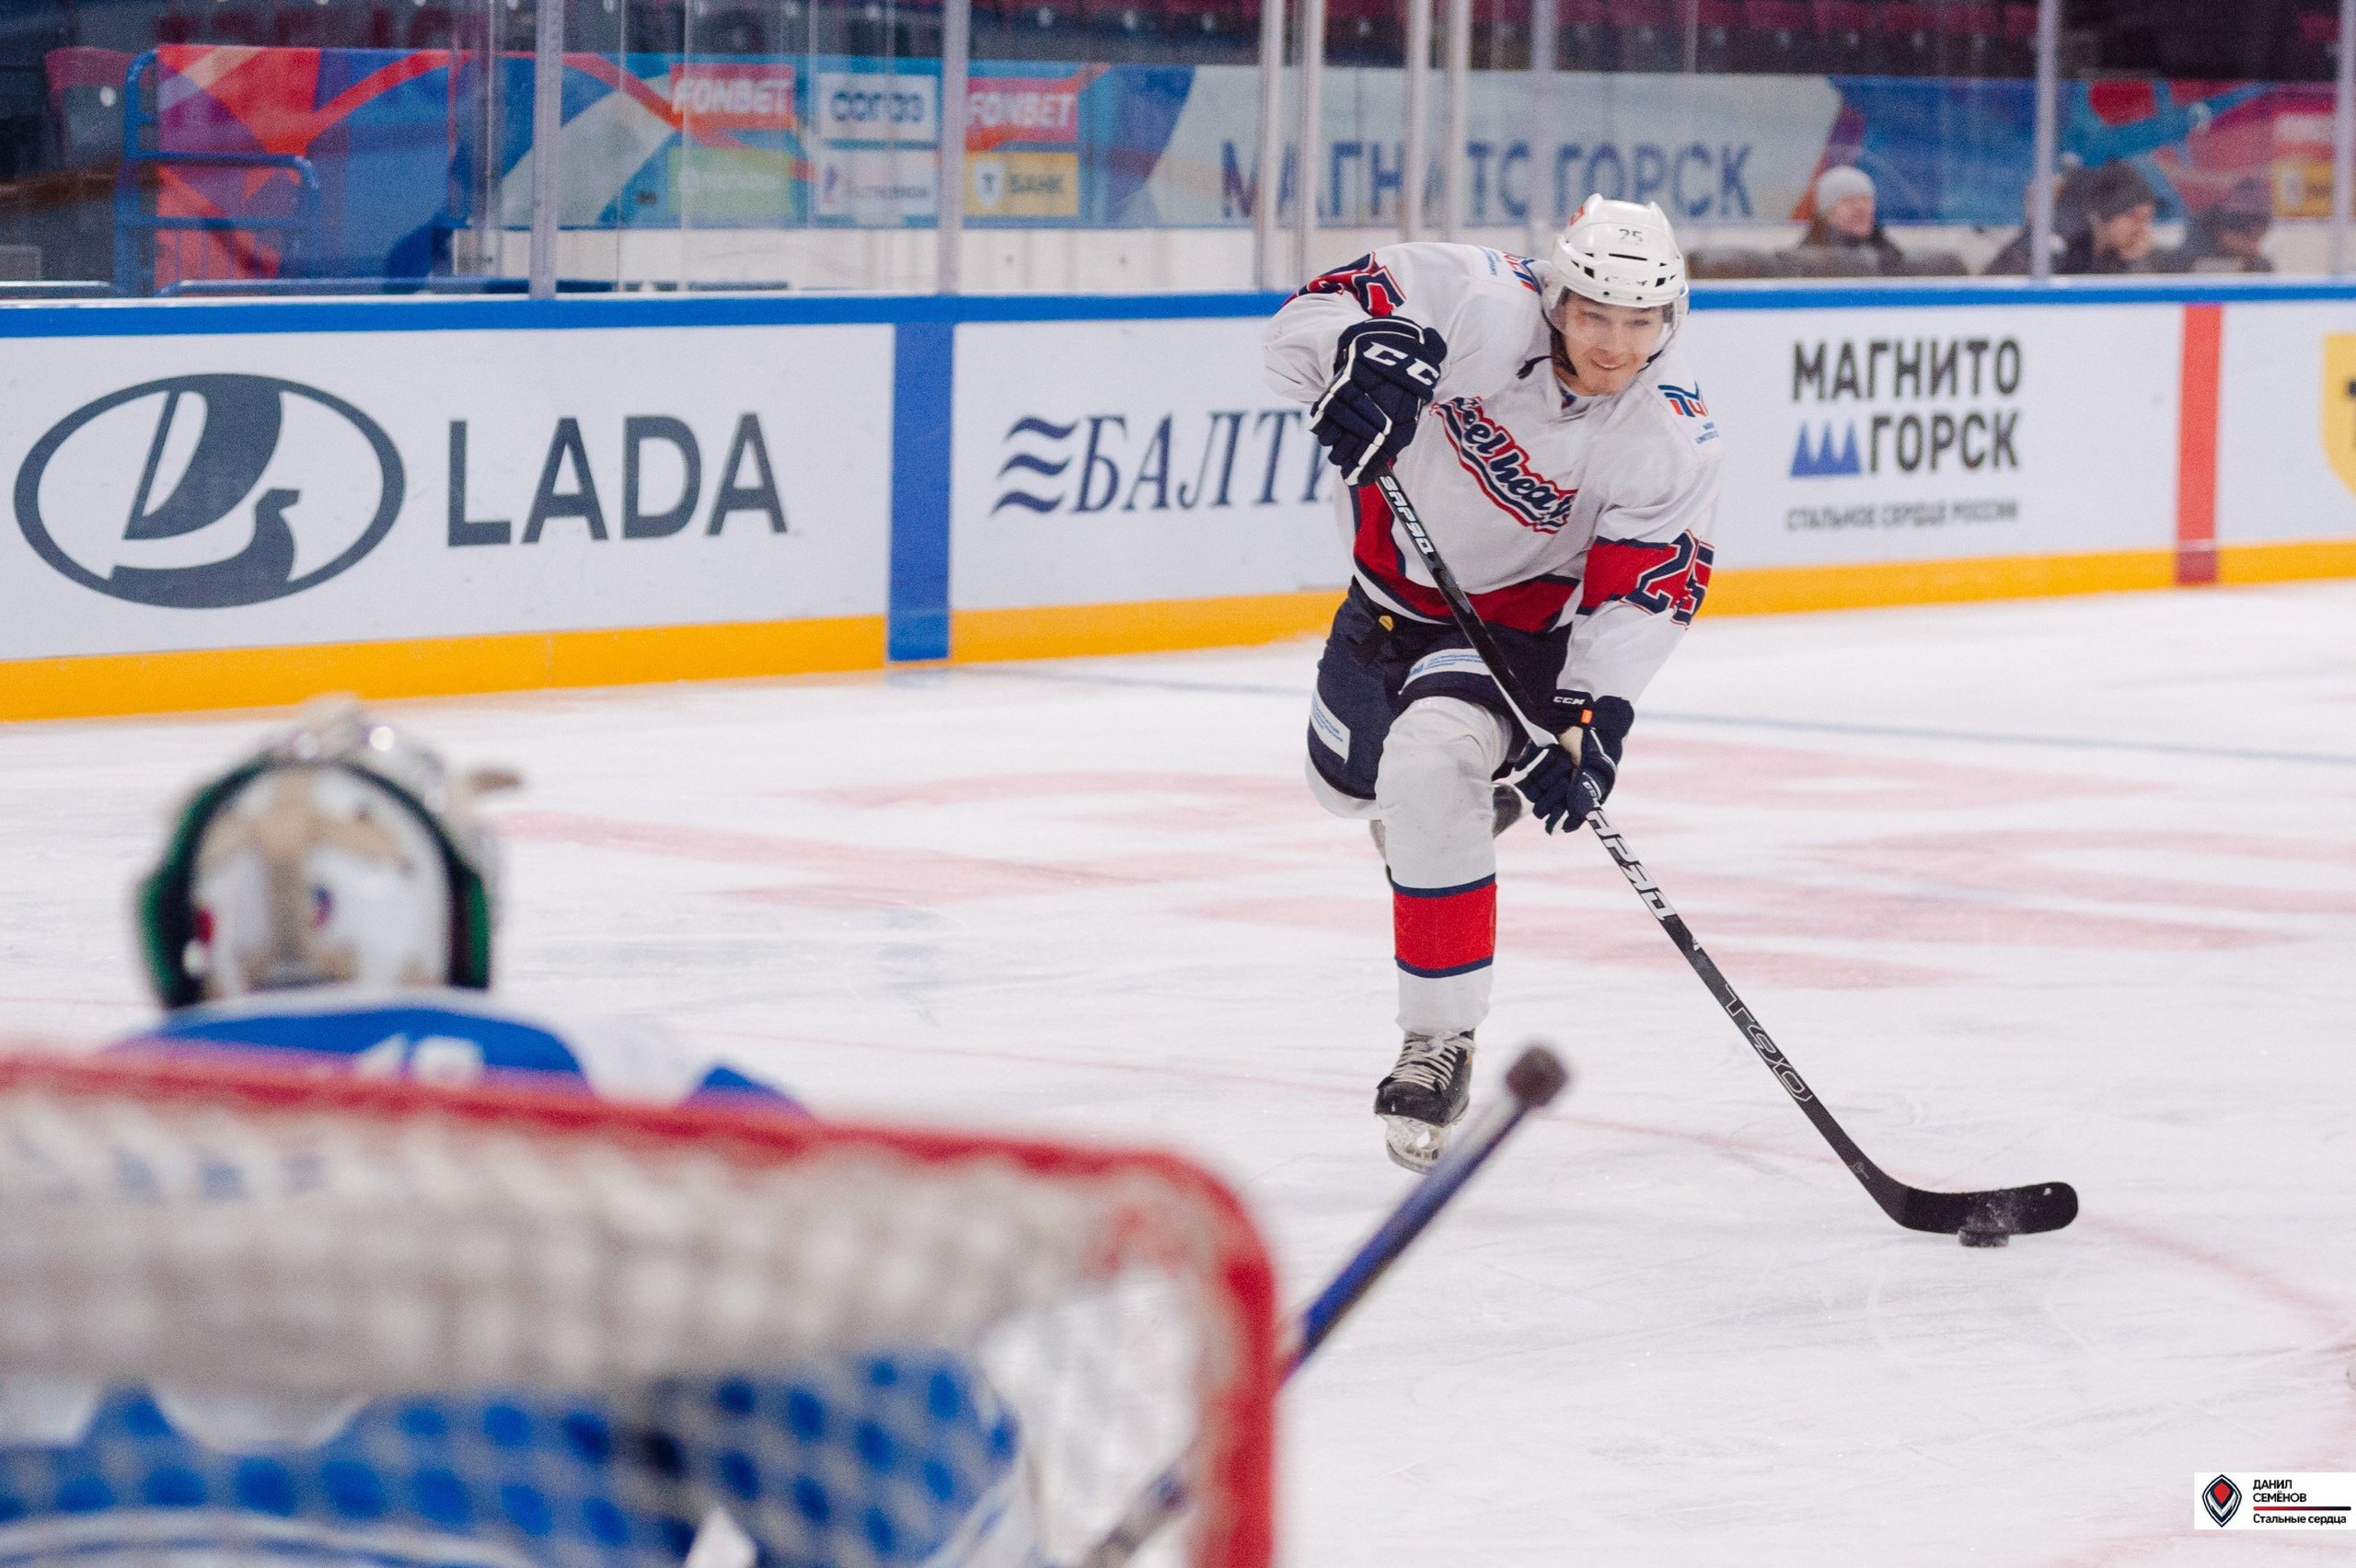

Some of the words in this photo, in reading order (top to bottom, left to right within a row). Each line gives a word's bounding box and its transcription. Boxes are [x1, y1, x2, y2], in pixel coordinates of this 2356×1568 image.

[671, 77, 791, 114] FONBET
[967, 93, 1074, 127] FONBET
[1363, 341, 1441, 386] CC
[1793, 335, 2022, 402] МАГНИТО
[1868, 410, 2021, 474] ГОРСК
[446, 413, 789, 548] LADA
[1622, 528, 1715, 628] 25
[1553, 697, 1586, 706] CCM
[1585, 809, 1680, 921] АРЯД
